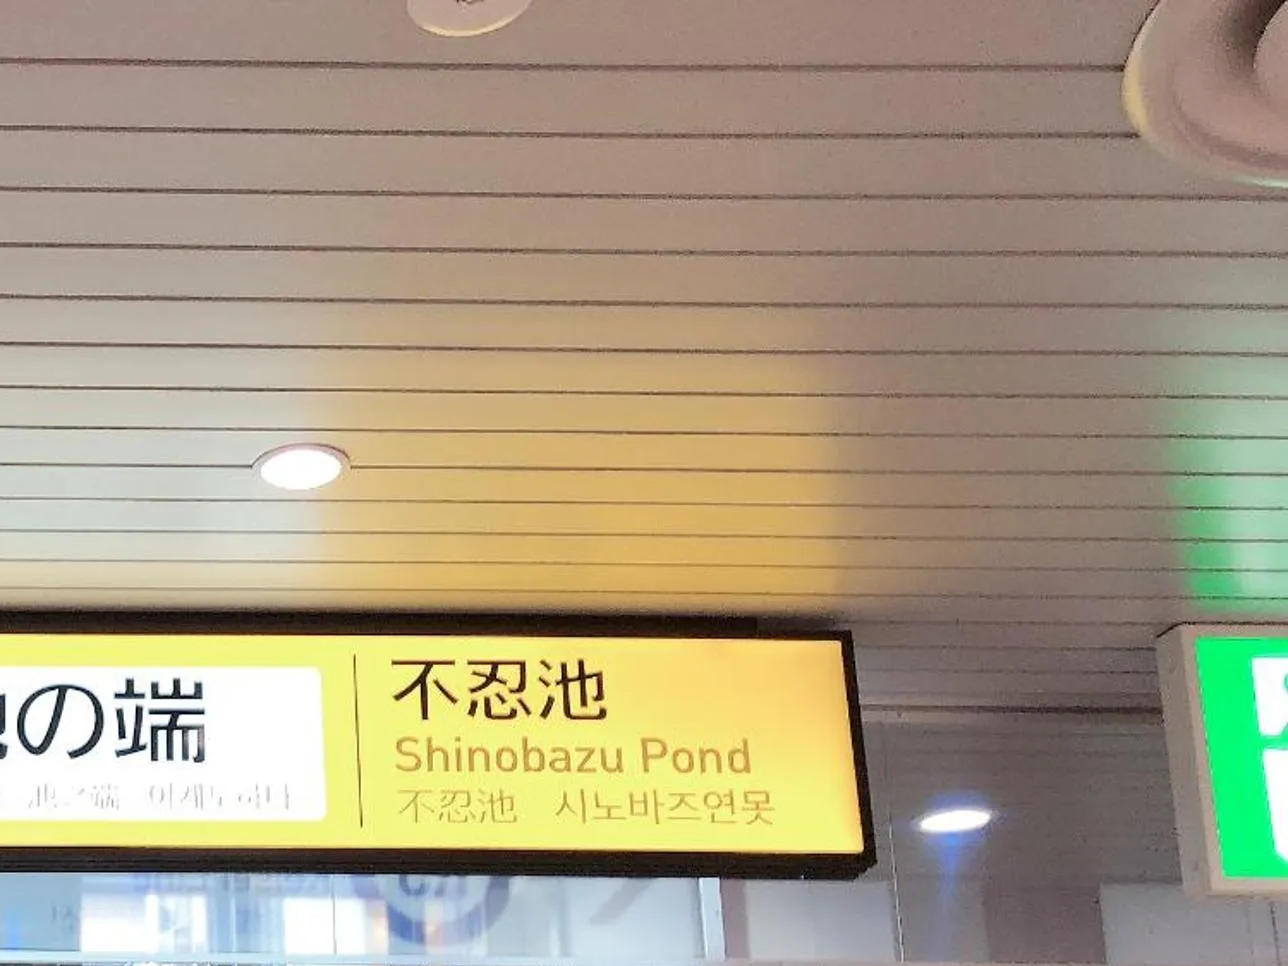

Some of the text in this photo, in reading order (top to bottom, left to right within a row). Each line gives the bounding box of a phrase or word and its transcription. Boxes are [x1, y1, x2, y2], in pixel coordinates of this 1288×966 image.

[391, 658, 607, 721] 不忍池
[395, 735, 751, 775] Shinobazu Pond
[397, 787, 518, 824] 不忍池
[555, 787, 776, 826] 시노바즈연못
